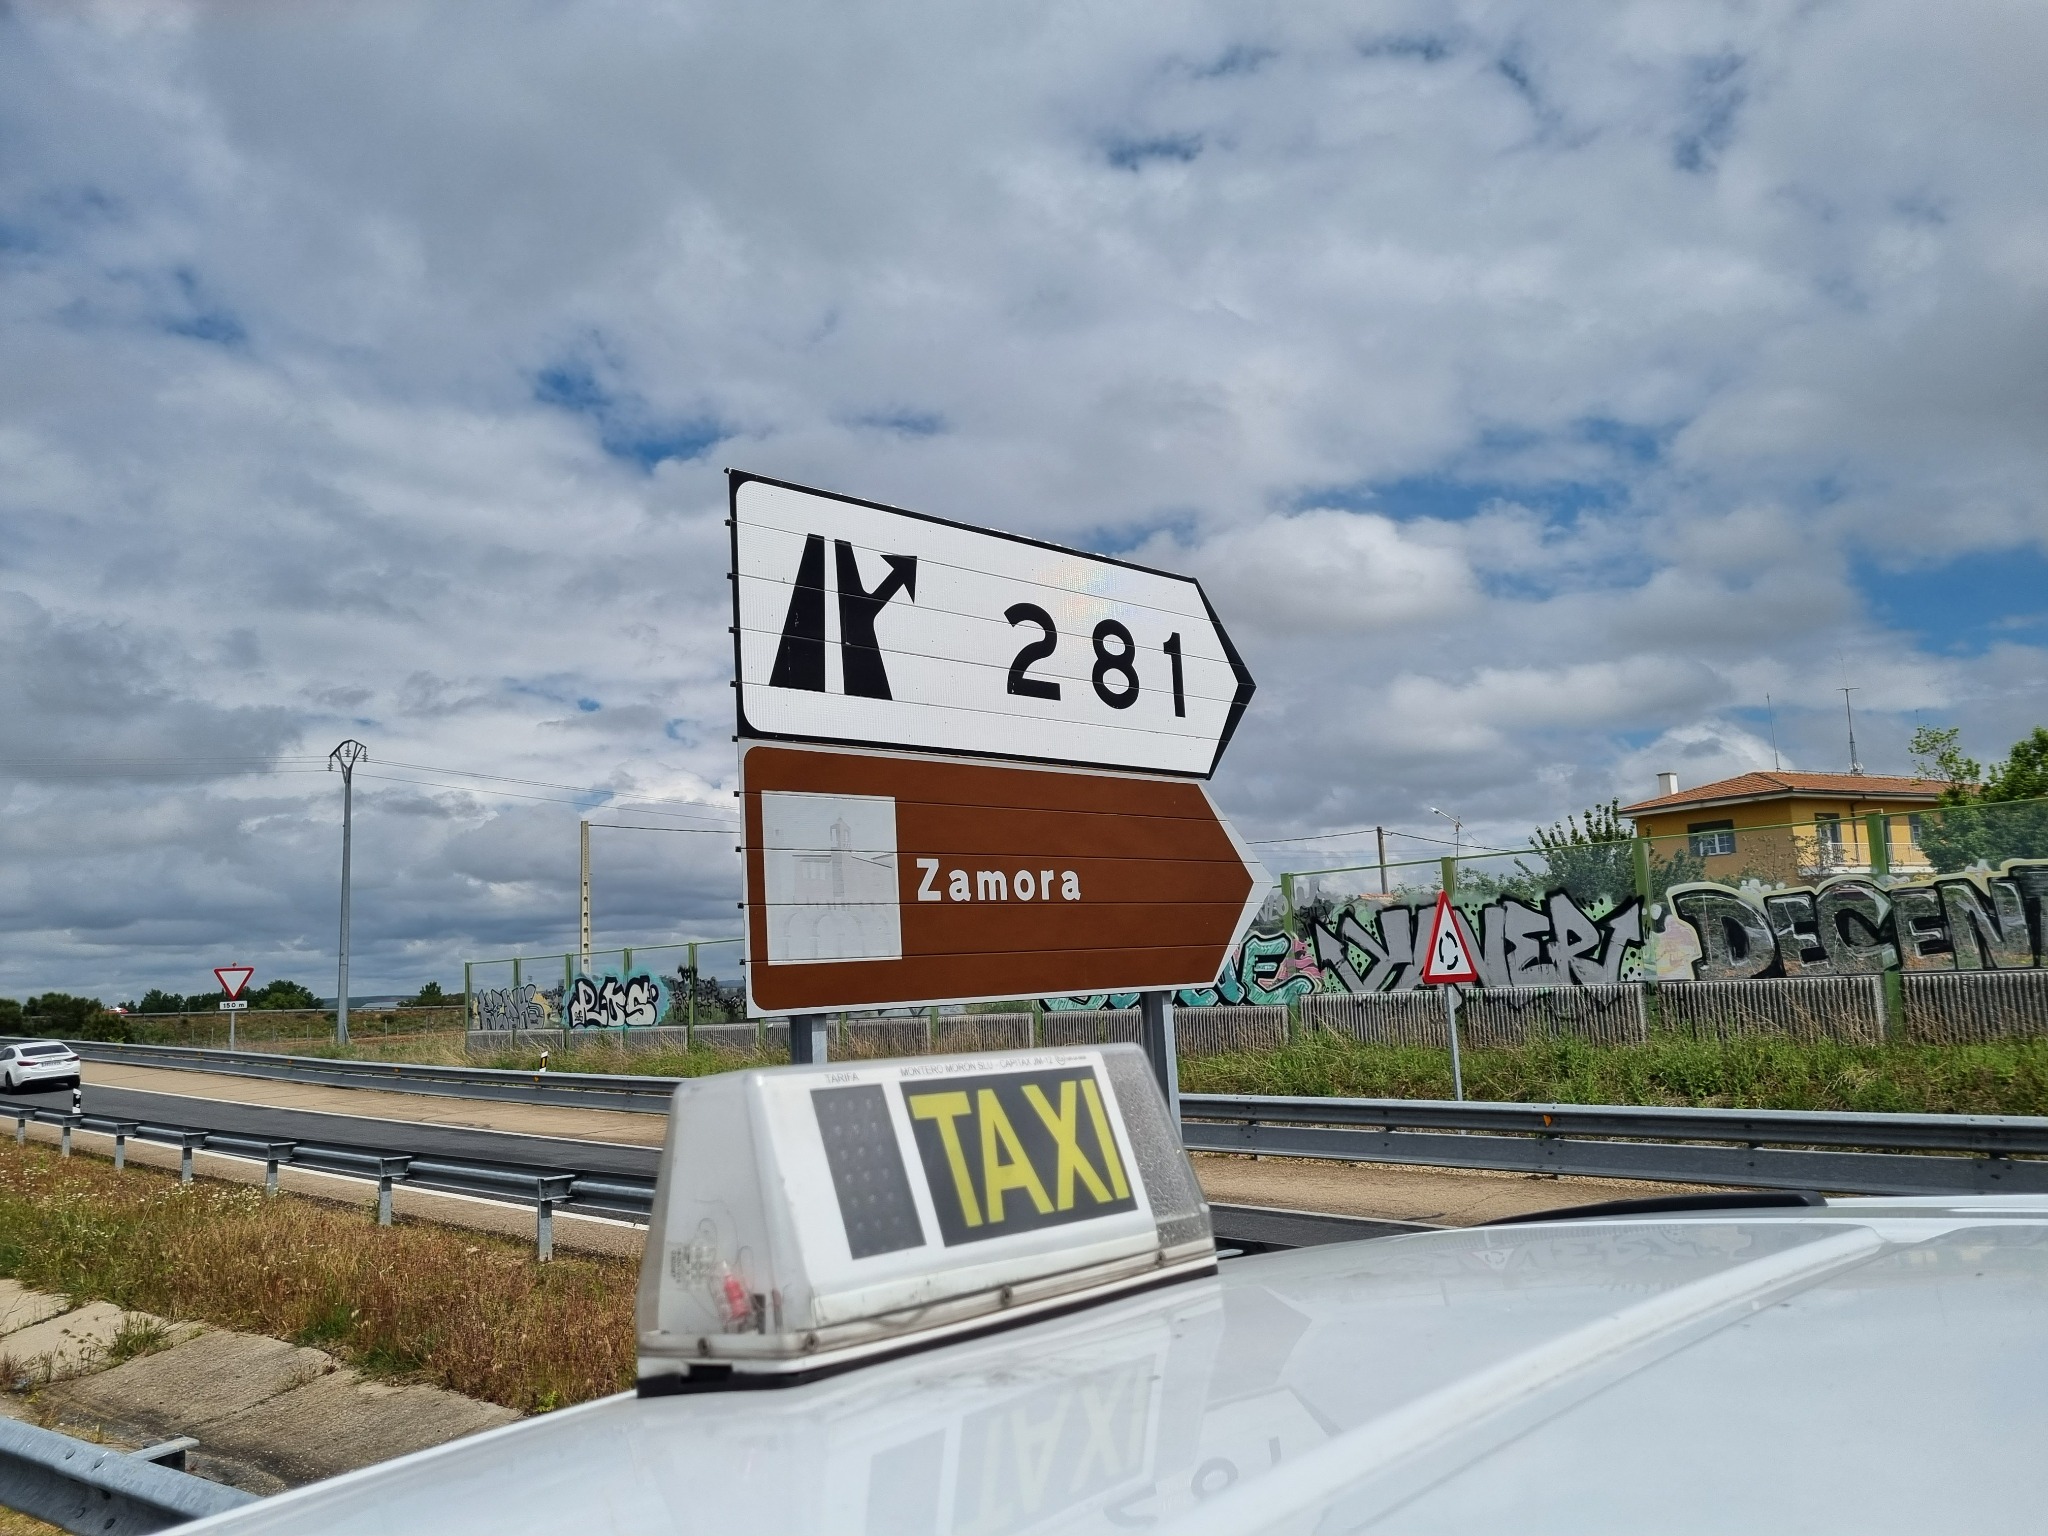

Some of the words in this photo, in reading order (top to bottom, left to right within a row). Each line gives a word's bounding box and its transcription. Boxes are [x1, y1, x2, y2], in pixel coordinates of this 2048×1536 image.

[1003, 602, 1187, 718] 281
[915, 858, 1082, 902] Zamora
[823, 1071, 860, 1083] TARIFA
[900, 1064, 944, 1077] MONTERO
[909, 1077, 1131, 1228] TAXI
